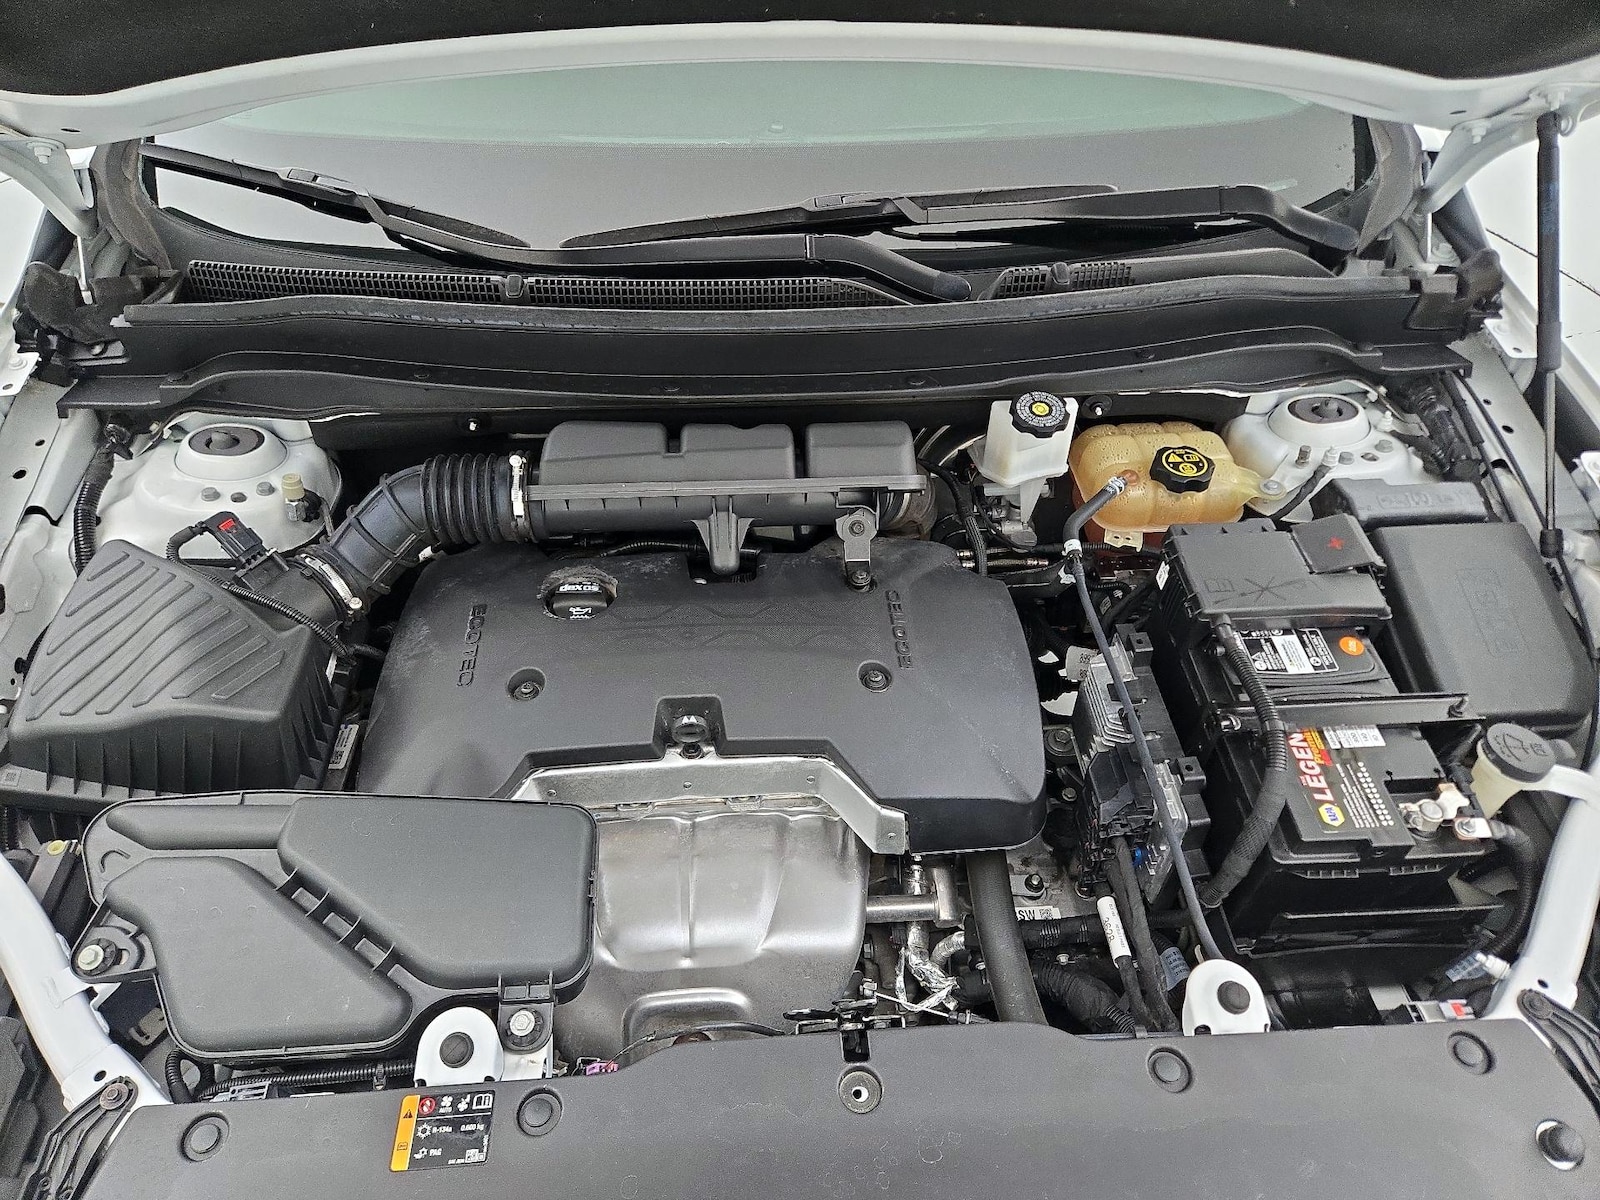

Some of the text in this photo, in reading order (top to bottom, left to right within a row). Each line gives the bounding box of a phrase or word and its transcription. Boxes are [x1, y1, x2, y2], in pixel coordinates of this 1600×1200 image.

[559, 583, 600, 592] dexos
[457, 604, 488, 687] ECOTEC
[885, 590, 914, 670] ECOTEC
[1288, 732, 1335, 801] LEGEN
[1325, 807, 1339, 823] NAPA
